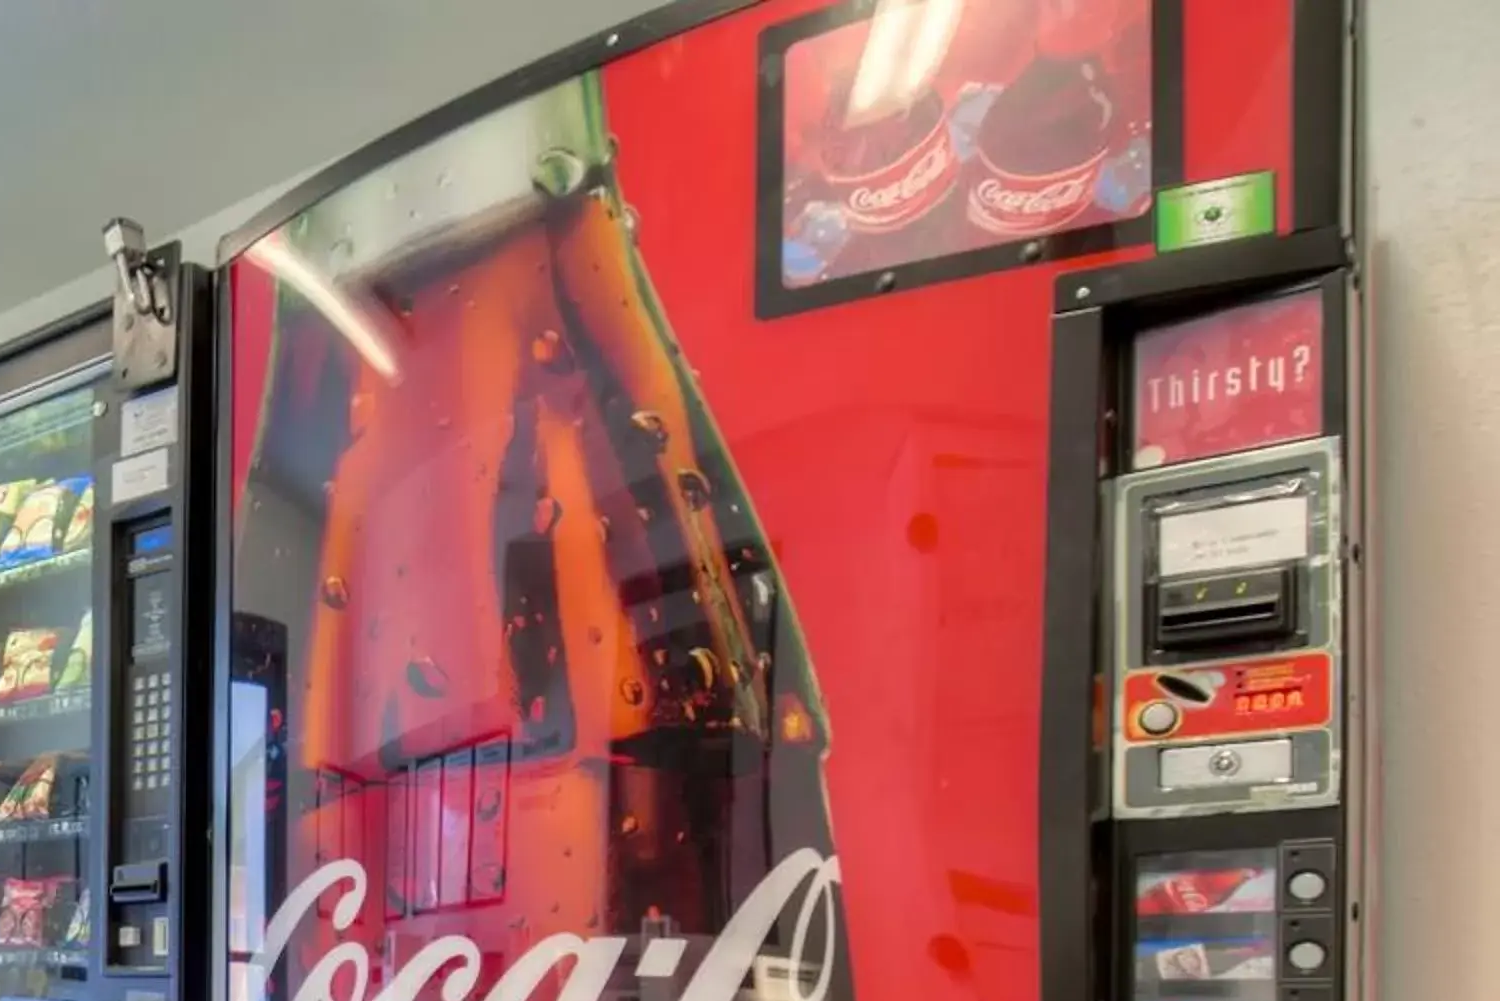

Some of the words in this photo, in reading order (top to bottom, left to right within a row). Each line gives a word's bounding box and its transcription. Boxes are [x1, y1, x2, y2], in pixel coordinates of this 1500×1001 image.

[849, 142, 947, 213] Coca-Cola
[976, 170, 1097, 215] Coca-Cola
[1147, 344, 1311, 413] Thirsty?
